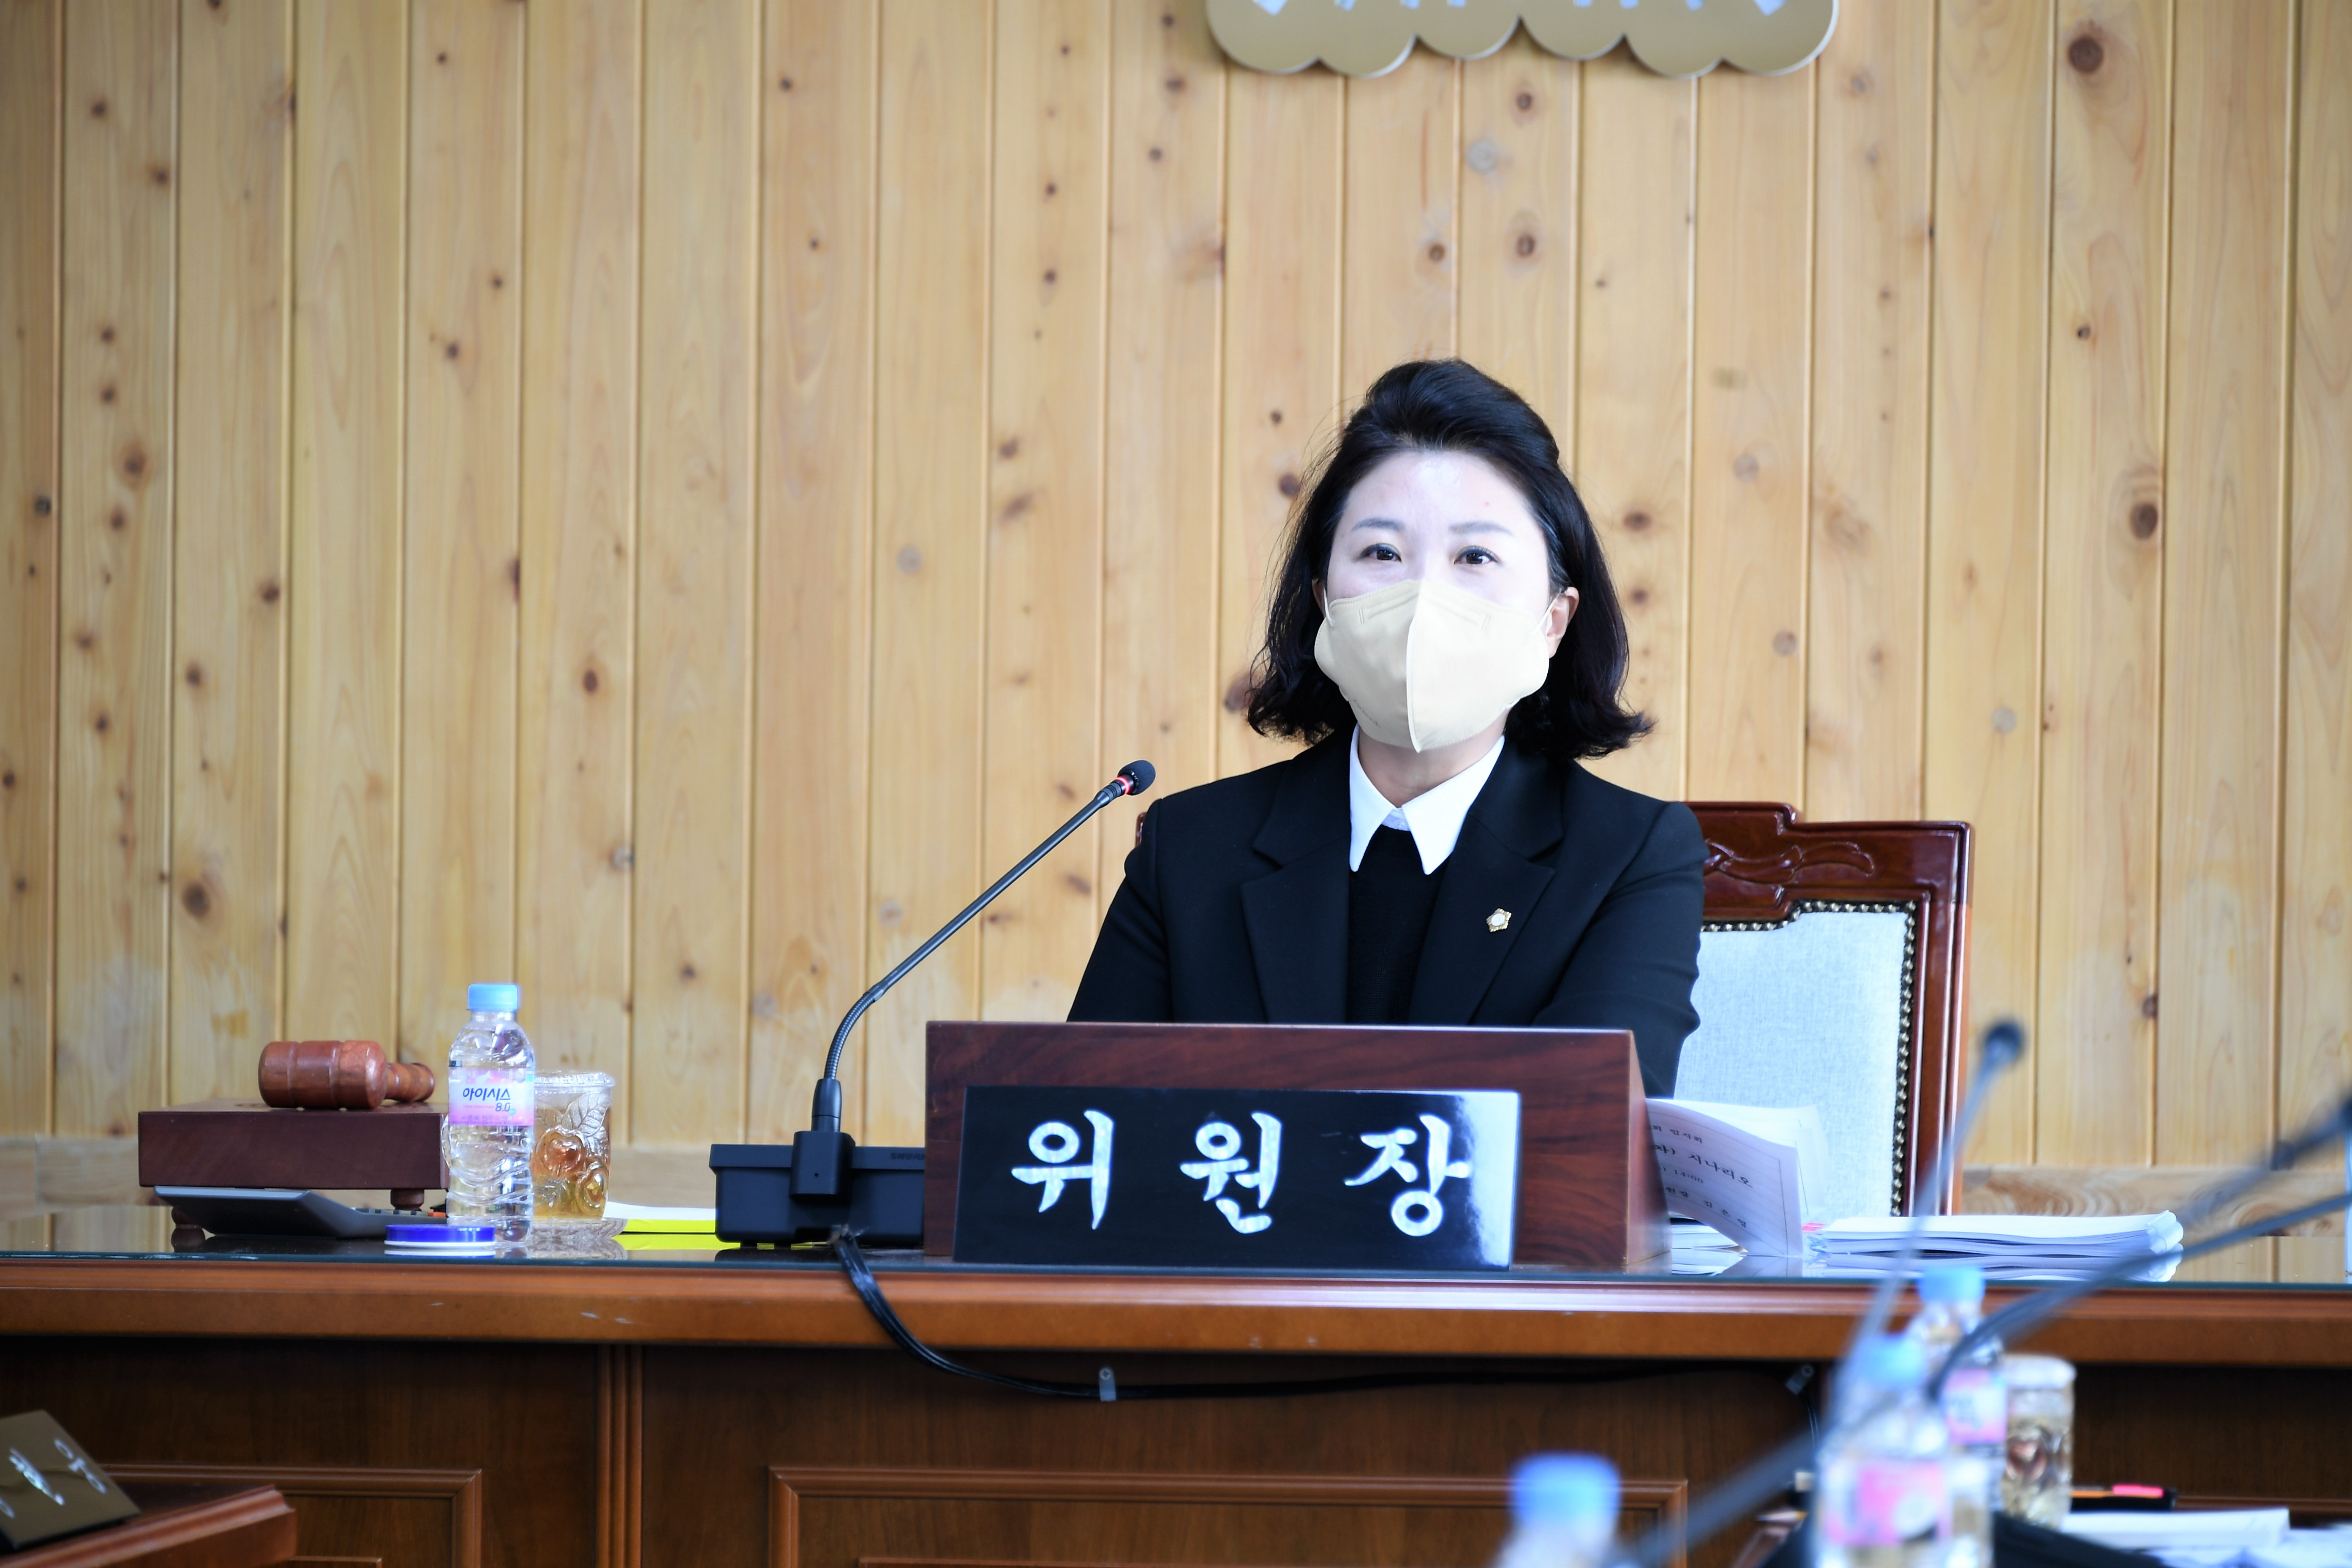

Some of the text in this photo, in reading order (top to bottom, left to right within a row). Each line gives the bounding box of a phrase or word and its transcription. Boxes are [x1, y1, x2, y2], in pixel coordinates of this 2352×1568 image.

[463, 1088, 511, 1101] 아이시스
[495, 1102, 510, 1112] 8.0
[1011, 1110, 1470, 1237] 위원장
[1674, 1169, 1704, 1184] 14:00
[1688, 1154, 1753, 1188] 시나리오
